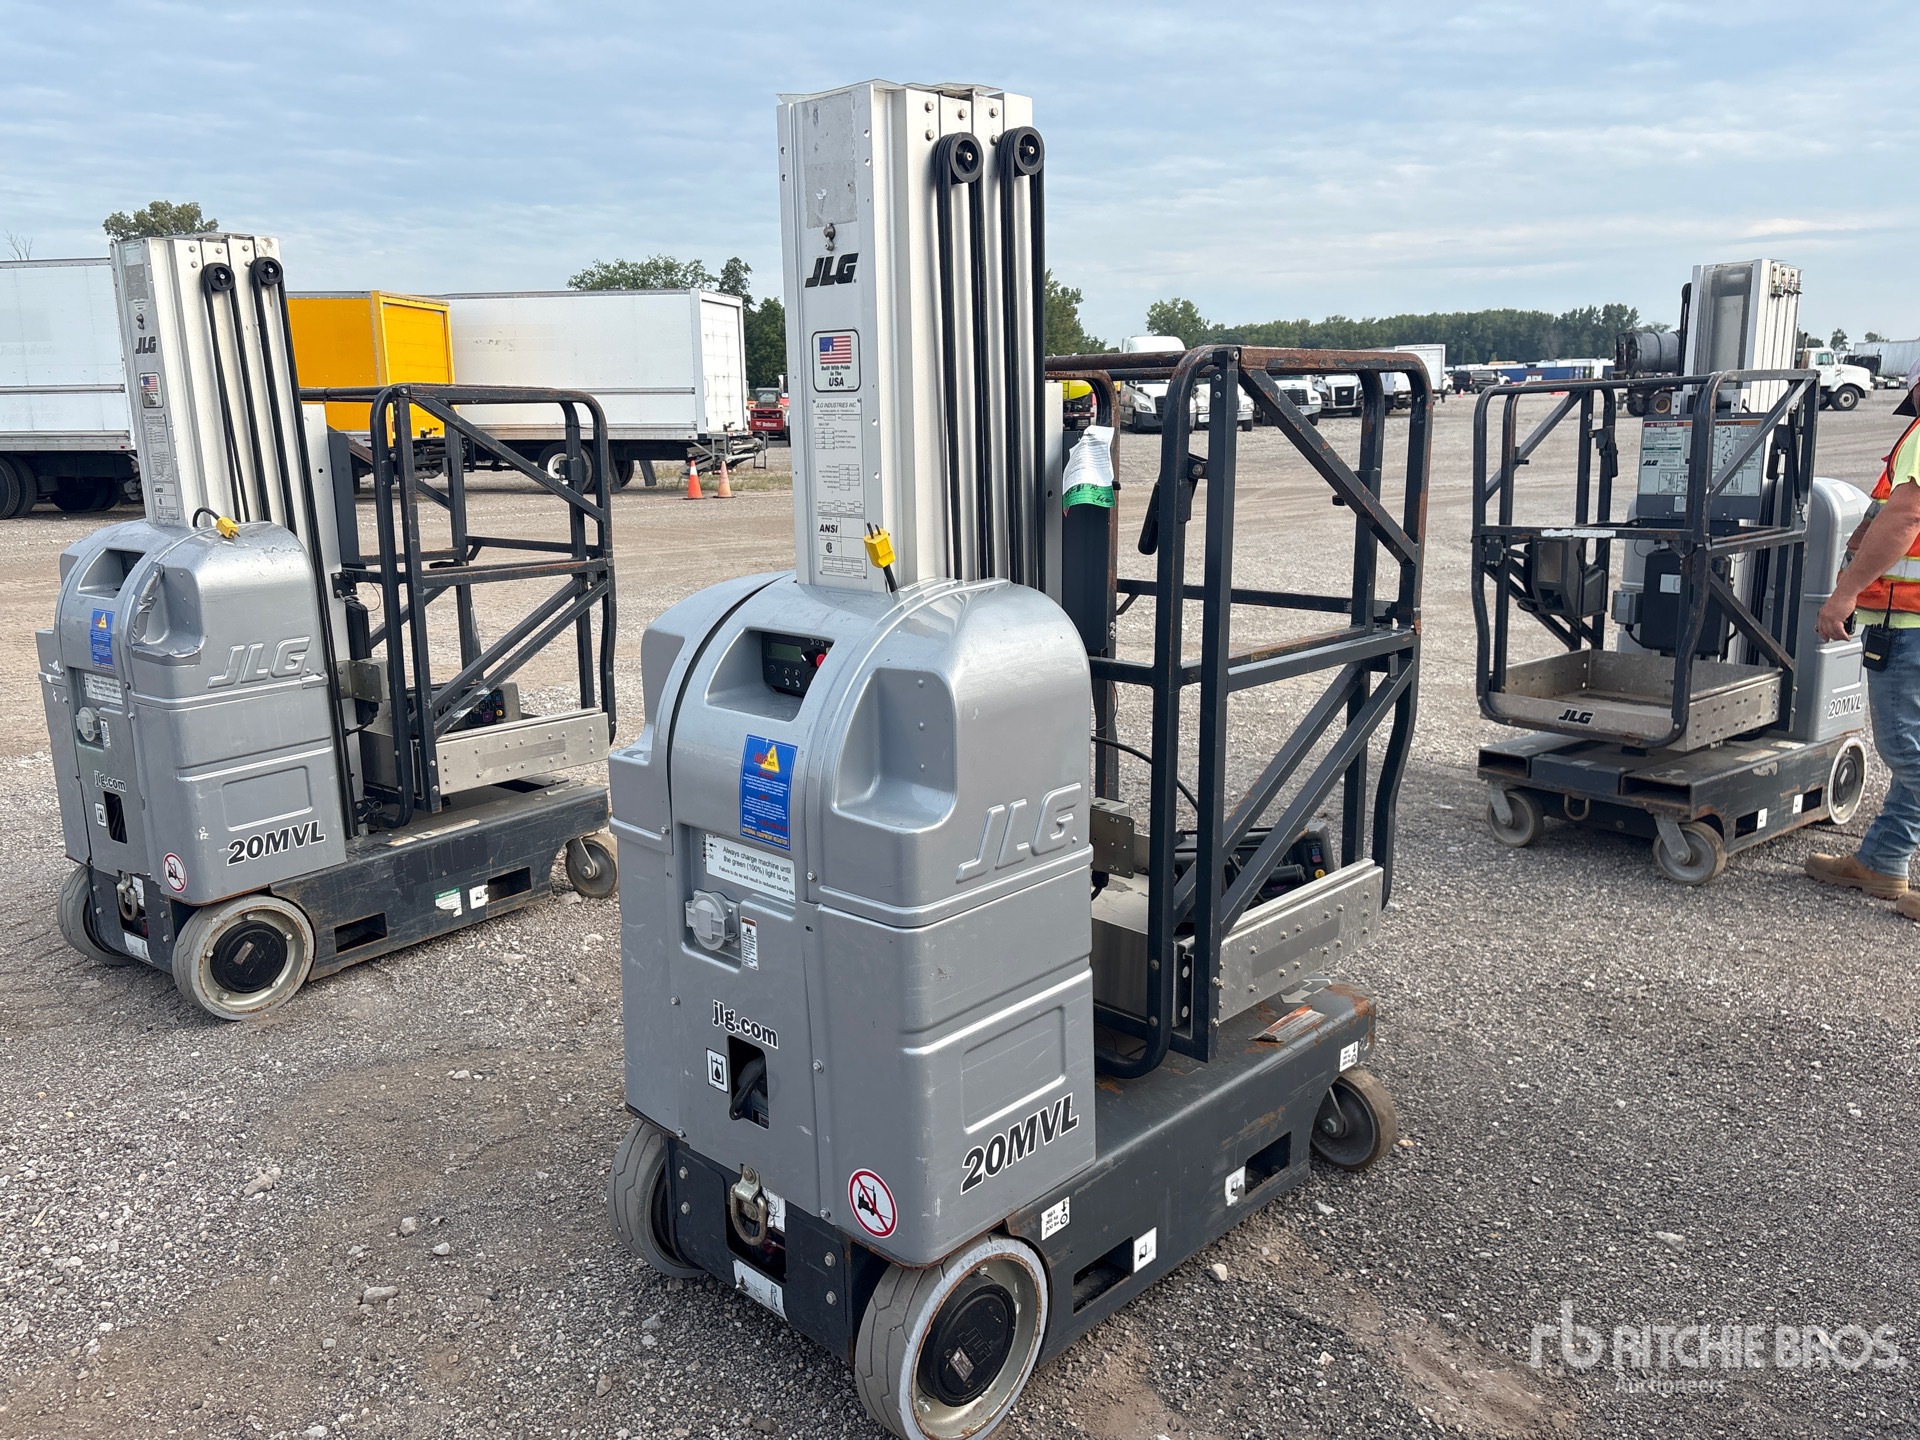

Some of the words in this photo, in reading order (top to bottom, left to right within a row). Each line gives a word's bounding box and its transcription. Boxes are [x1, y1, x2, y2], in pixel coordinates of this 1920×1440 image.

[805, 253, 857, 288] JLG
[135, 336, 157, 355] JLG
[828, 377, 845, 387] USA
[819, 524, 839, 534] ANSI
[207, 636, 311, 689] JLG
[1557, 709, 1594, 725] JLG
[1828, 693, 1862, 720] 20MVL
[93, 769, 127, 793] jlg.com
[227, 820, 326, 867] 20MVL
[956, 782, 1081, 885] JLG
[723, 846, 740, 858] Always
[741, 853, 757, 863] charge
[758, 859, 779, 870] machine
[780, 865, 790, 874] until
[723, 855, 731, 863] the
[732, 858, 746, 868] green
[747, 863, 764, 875] (100%)
[765, 867, 775, 878] light
[719, 865, 730, 873] Failure
[763, 881, 777, 889] reduced
[777, 886, 789, 894] battery
[712, 999, 779, 1049] jlg.com
[960, 1092, 1080, 1195] 20MVL
